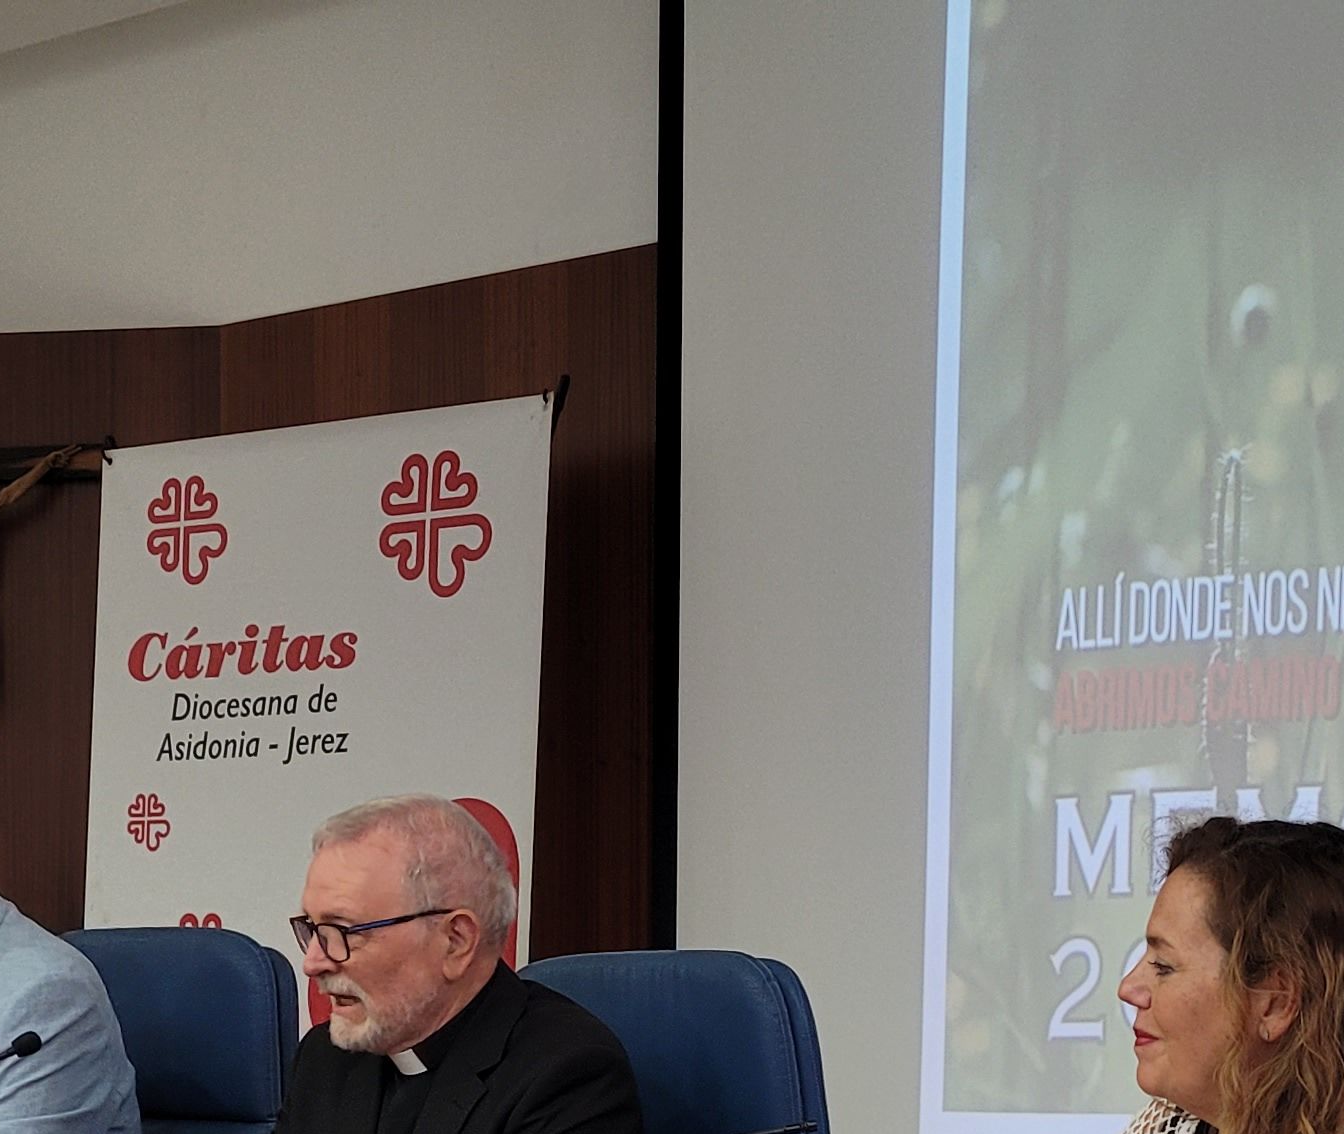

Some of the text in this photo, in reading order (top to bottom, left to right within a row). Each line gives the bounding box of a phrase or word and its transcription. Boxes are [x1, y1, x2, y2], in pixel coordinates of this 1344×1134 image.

[1056, 571, 1125, 650] ALLÍ
[1128, 574, 1236, 646] DONDE
[1242, 567, 1310, 640] NOS
[127, 623, 358, 682] Cáritas
[171, 683, 338, 721] Diocesana de
[1053, 661, 1198, 735] ABRIMOS
[1205, 655, 1341, 723] CAMINO
[155, 730, 260, 762] Asidonia
[282, 726, 350, 765] Jerez
